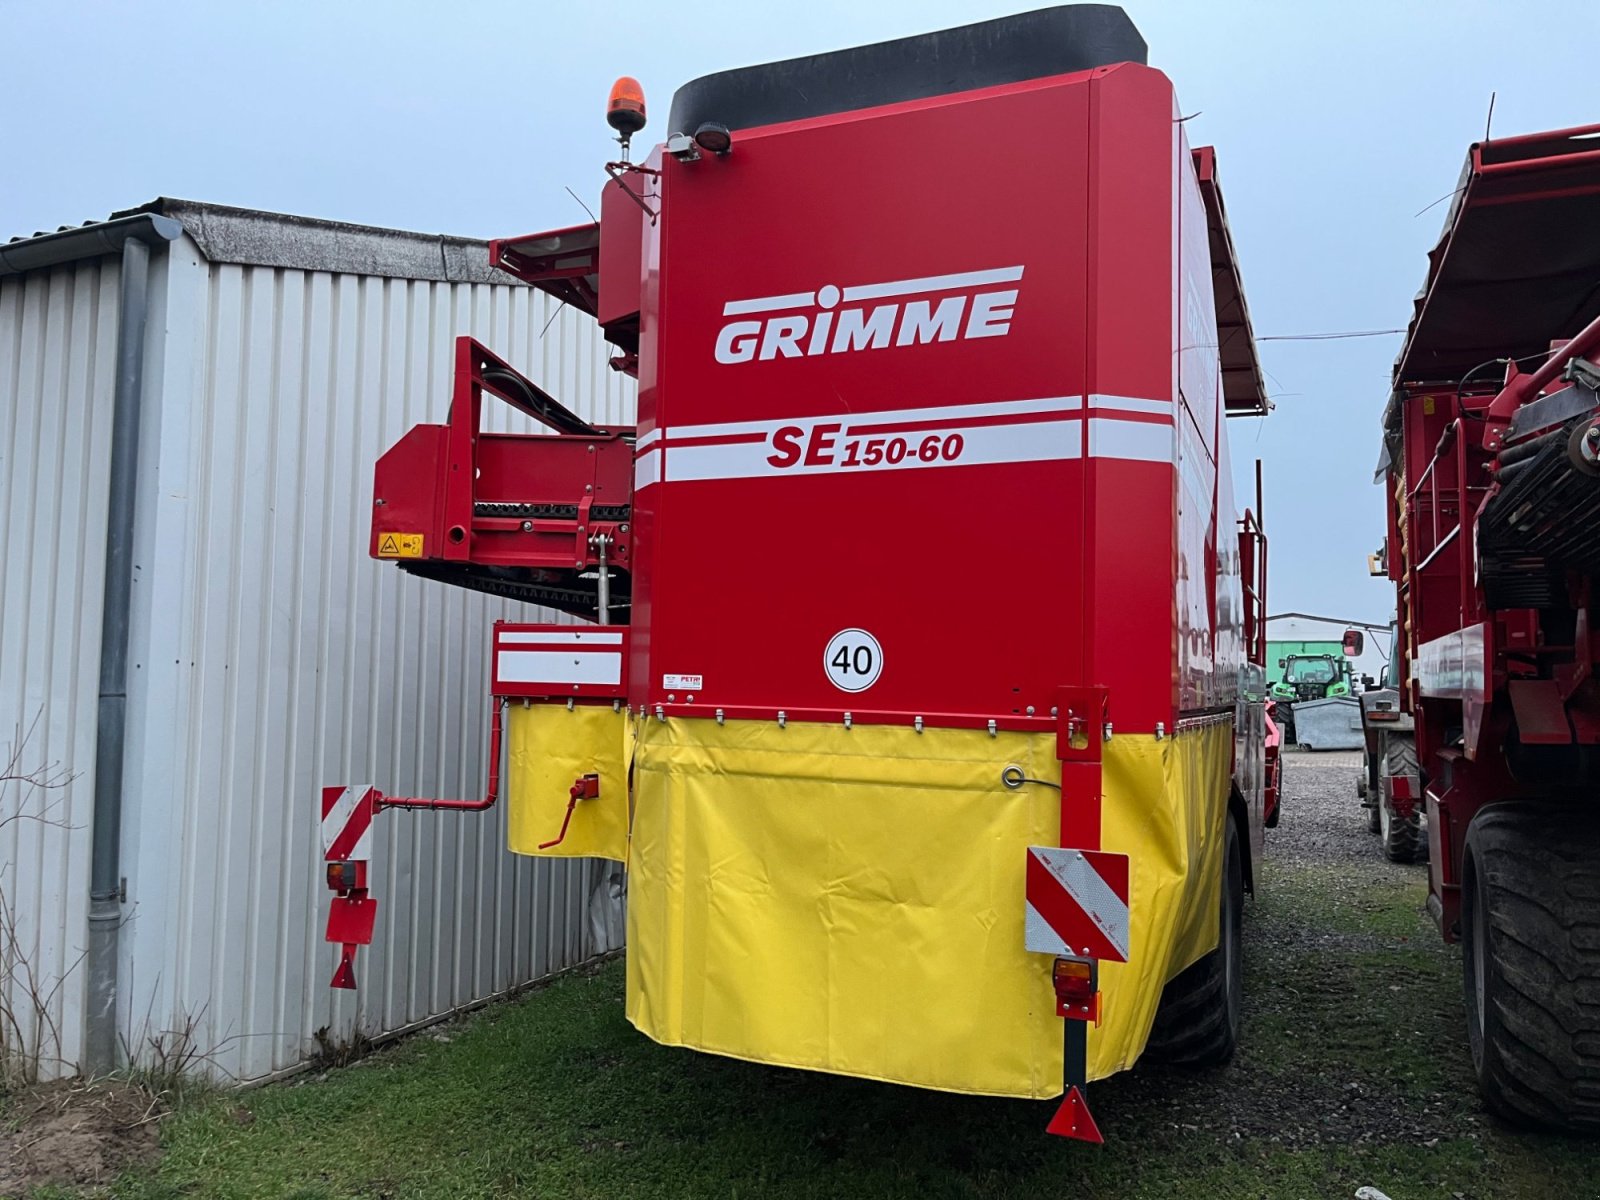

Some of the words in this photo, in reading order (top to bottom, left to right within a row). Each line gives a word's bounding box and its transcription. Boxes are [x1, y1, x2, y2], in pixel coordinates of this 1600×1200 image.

[714, 284, 1019, 365] GRIMME
[766, 423, 842, 469] SE
[840, 433, 964, 467] 150-60
[831, 645, 873, 675] 40
